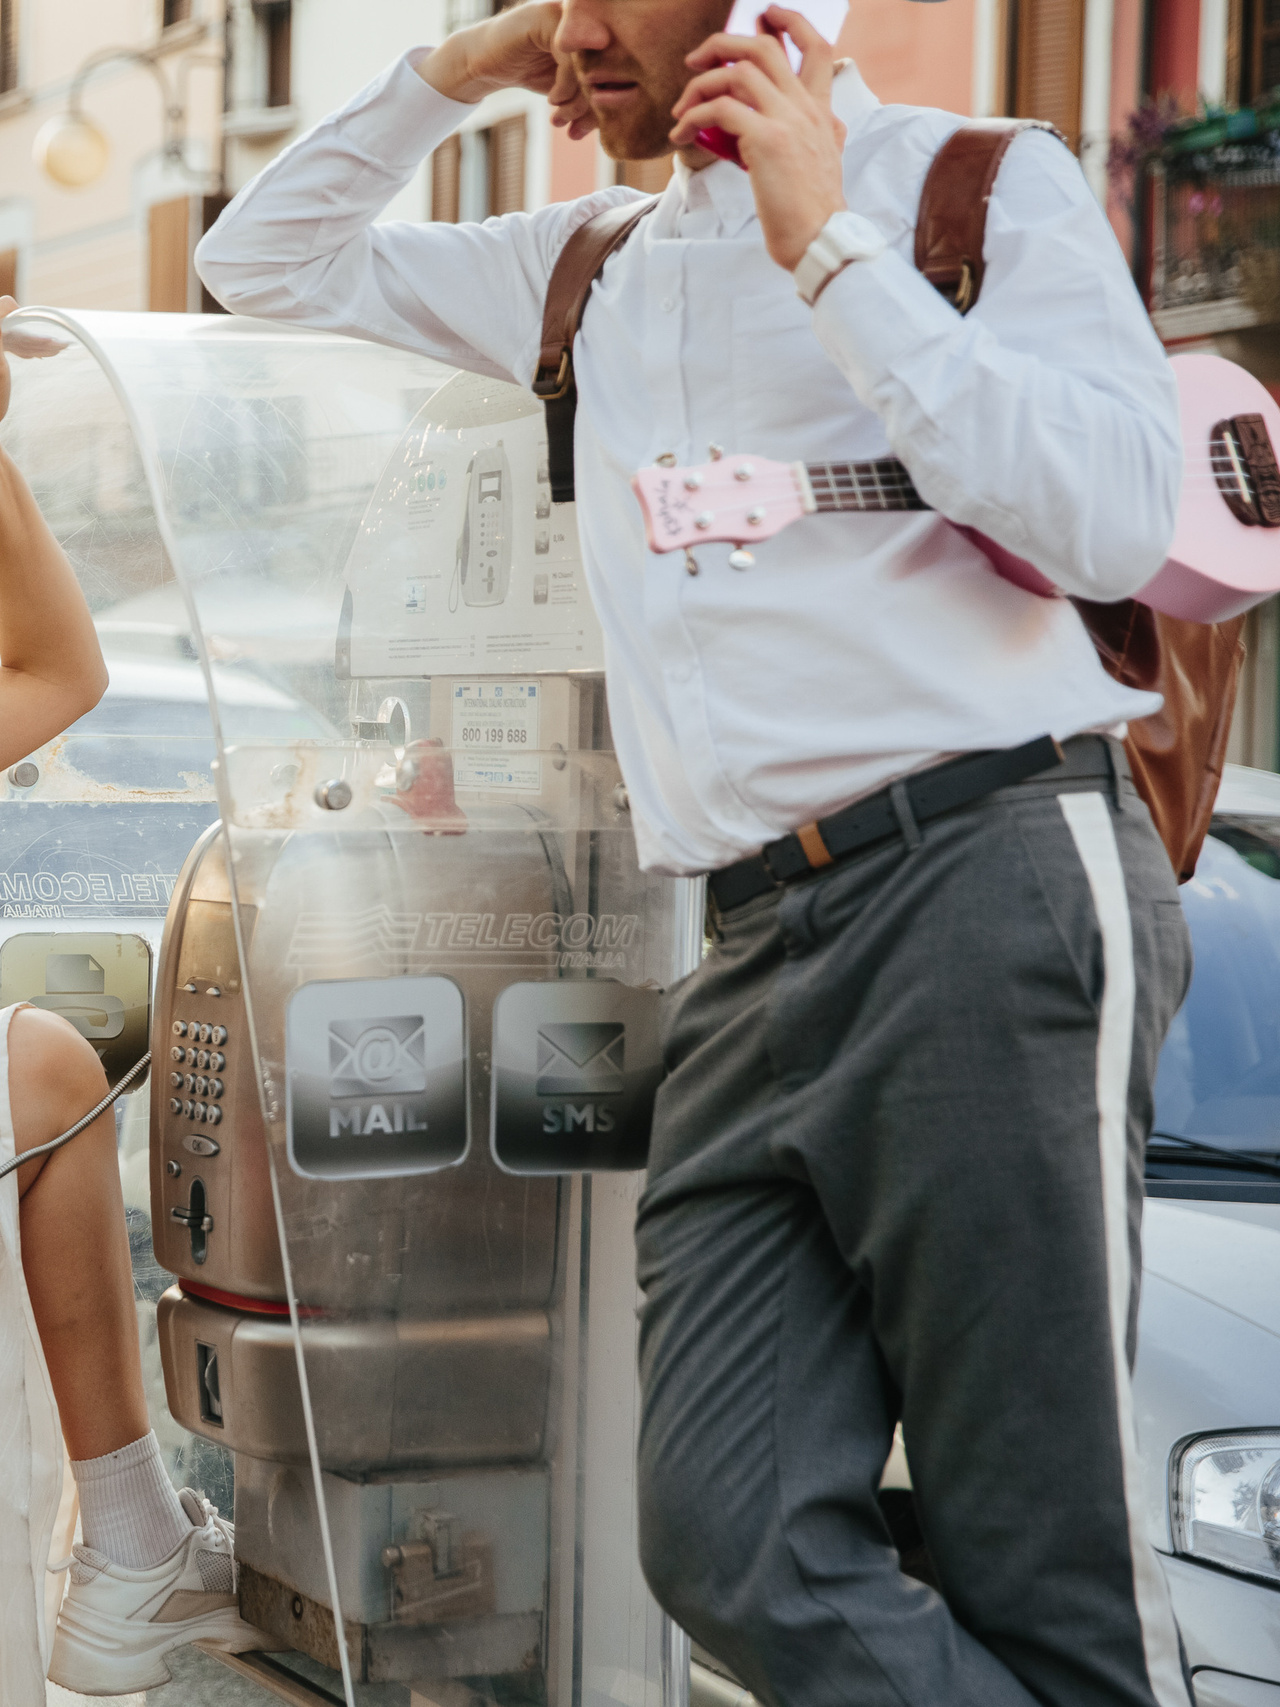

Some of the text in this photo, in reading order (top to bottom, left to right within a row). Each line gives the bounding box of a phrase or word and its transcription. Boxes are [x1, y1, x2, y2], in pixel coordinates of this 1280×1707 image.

[462, 727, 527, 744] 800 199 688
[423, 912, 638, 949] TELECOM
[559, 951, 626, 968] ITALIA
[329, 1103, 428, 1138] MAIL
[542, 1103, 617, 1133] SMS
